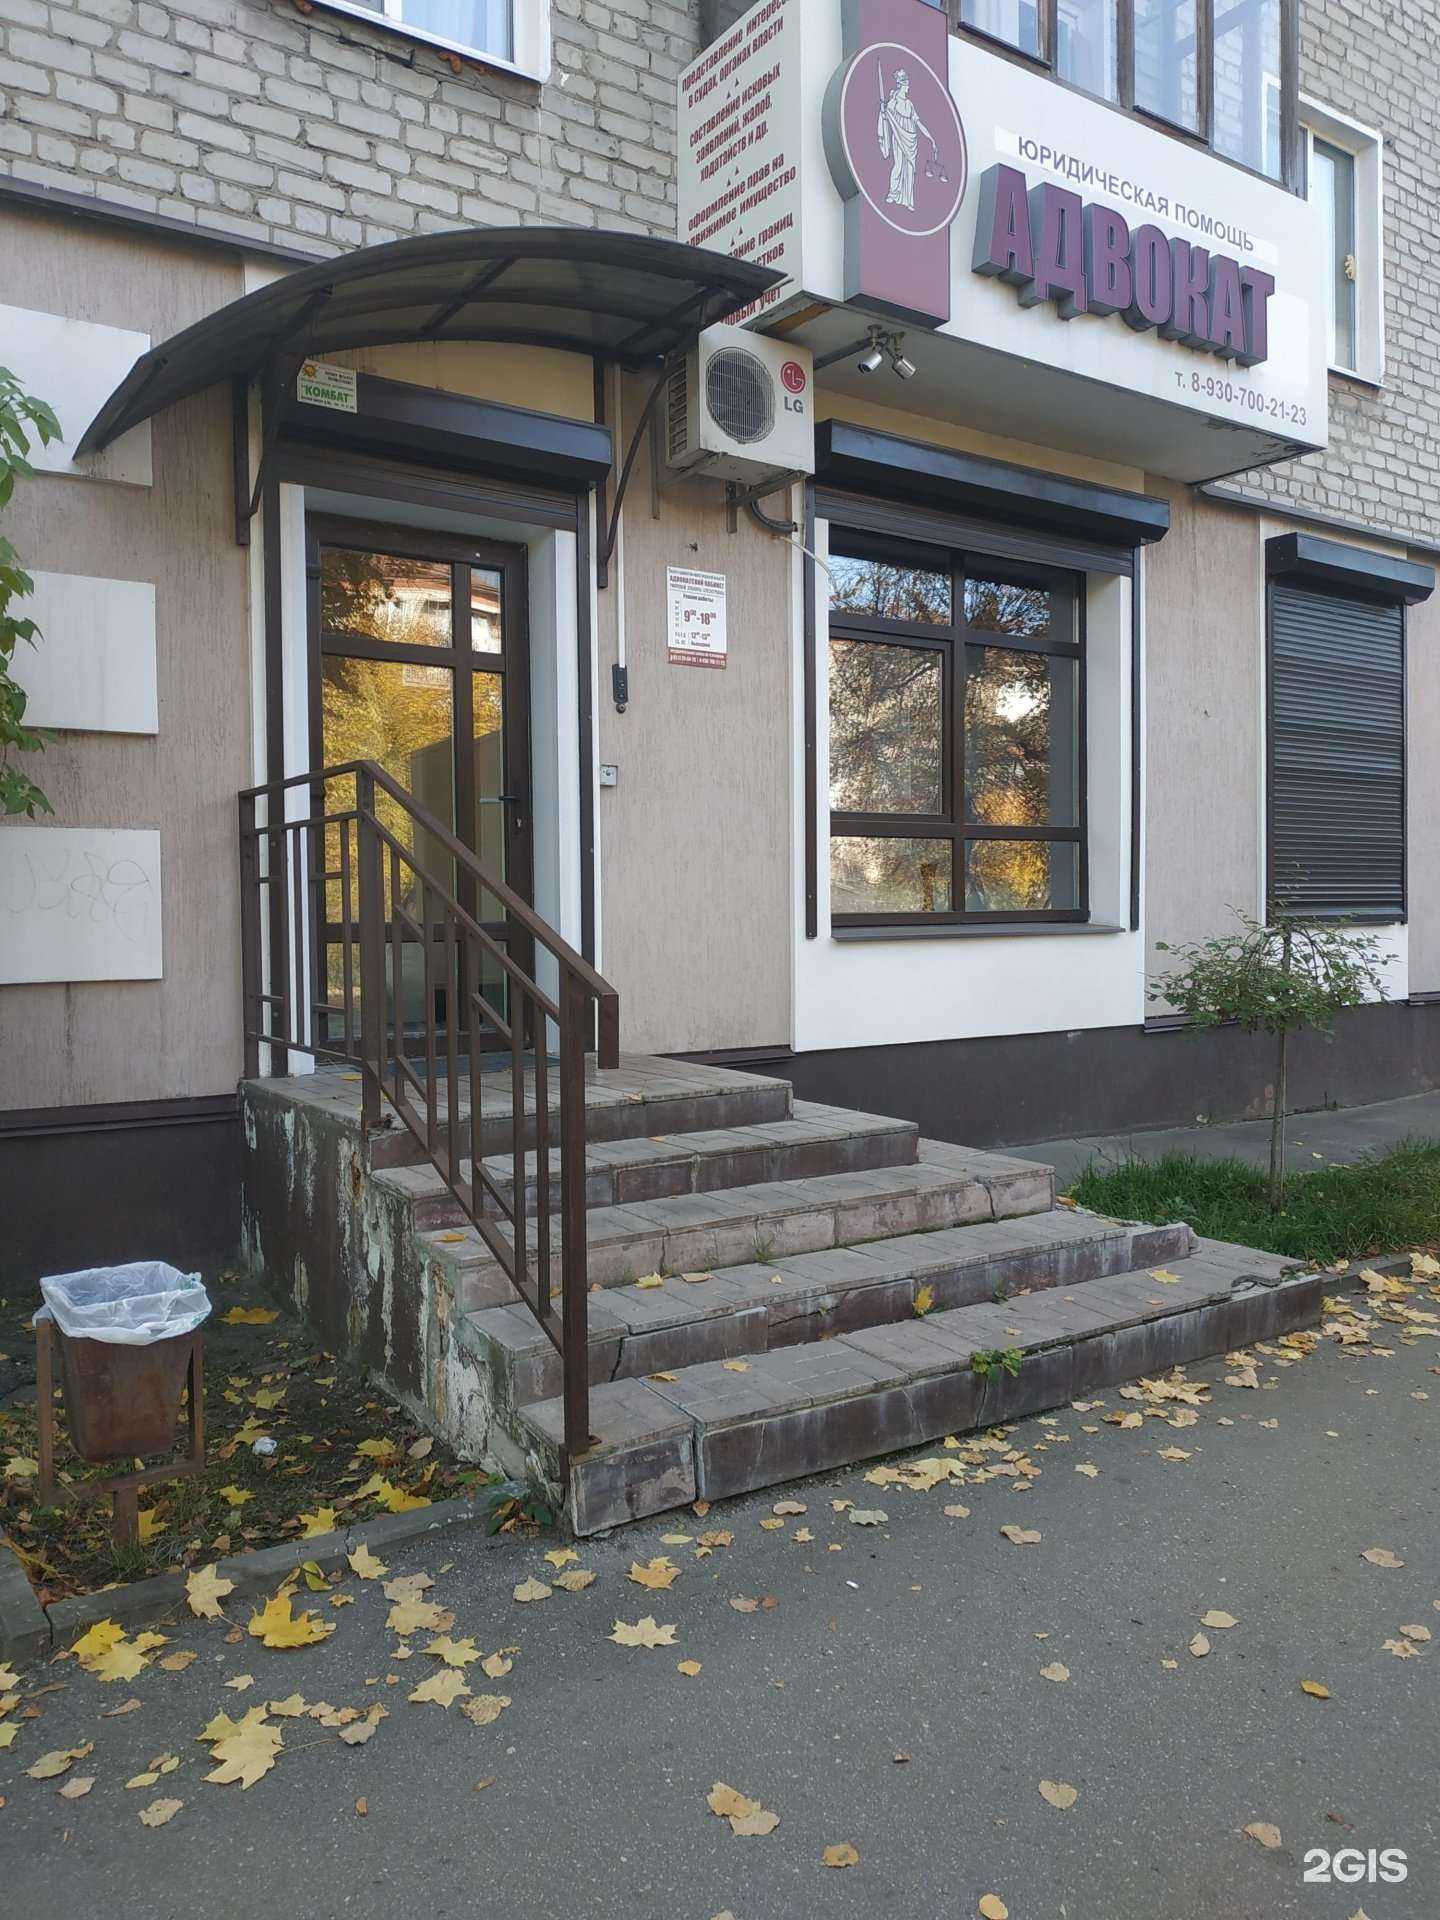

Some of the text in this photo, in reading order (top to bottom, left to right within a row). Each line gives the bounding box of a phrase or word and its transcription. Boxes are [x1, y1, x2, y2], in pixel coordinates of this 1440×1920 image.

[682, 0, 789, 93] представление интерес
[688, 16, 784, 109] в судах, органах власти
[690, 62, 780, 148] составление исковых
[700, 121, 769, 182] ходатайств и др.
[686, 166, 796, 247] движимое имущество
[688, 153, 784, 232] оформление прав на
[1018, 136, 1255, 252] ЮРИДИЧЕСКАЯ ПОМОЩЬ
[728, 212, 793, 258] ание границ
[752, 243, 785, 267] стков
[972, 162, 1276, 368] АДВОКАТ
[784, 396, 804, 414] LG
[1174, 371, 1307, 426] т. 8-930-700-21-23
